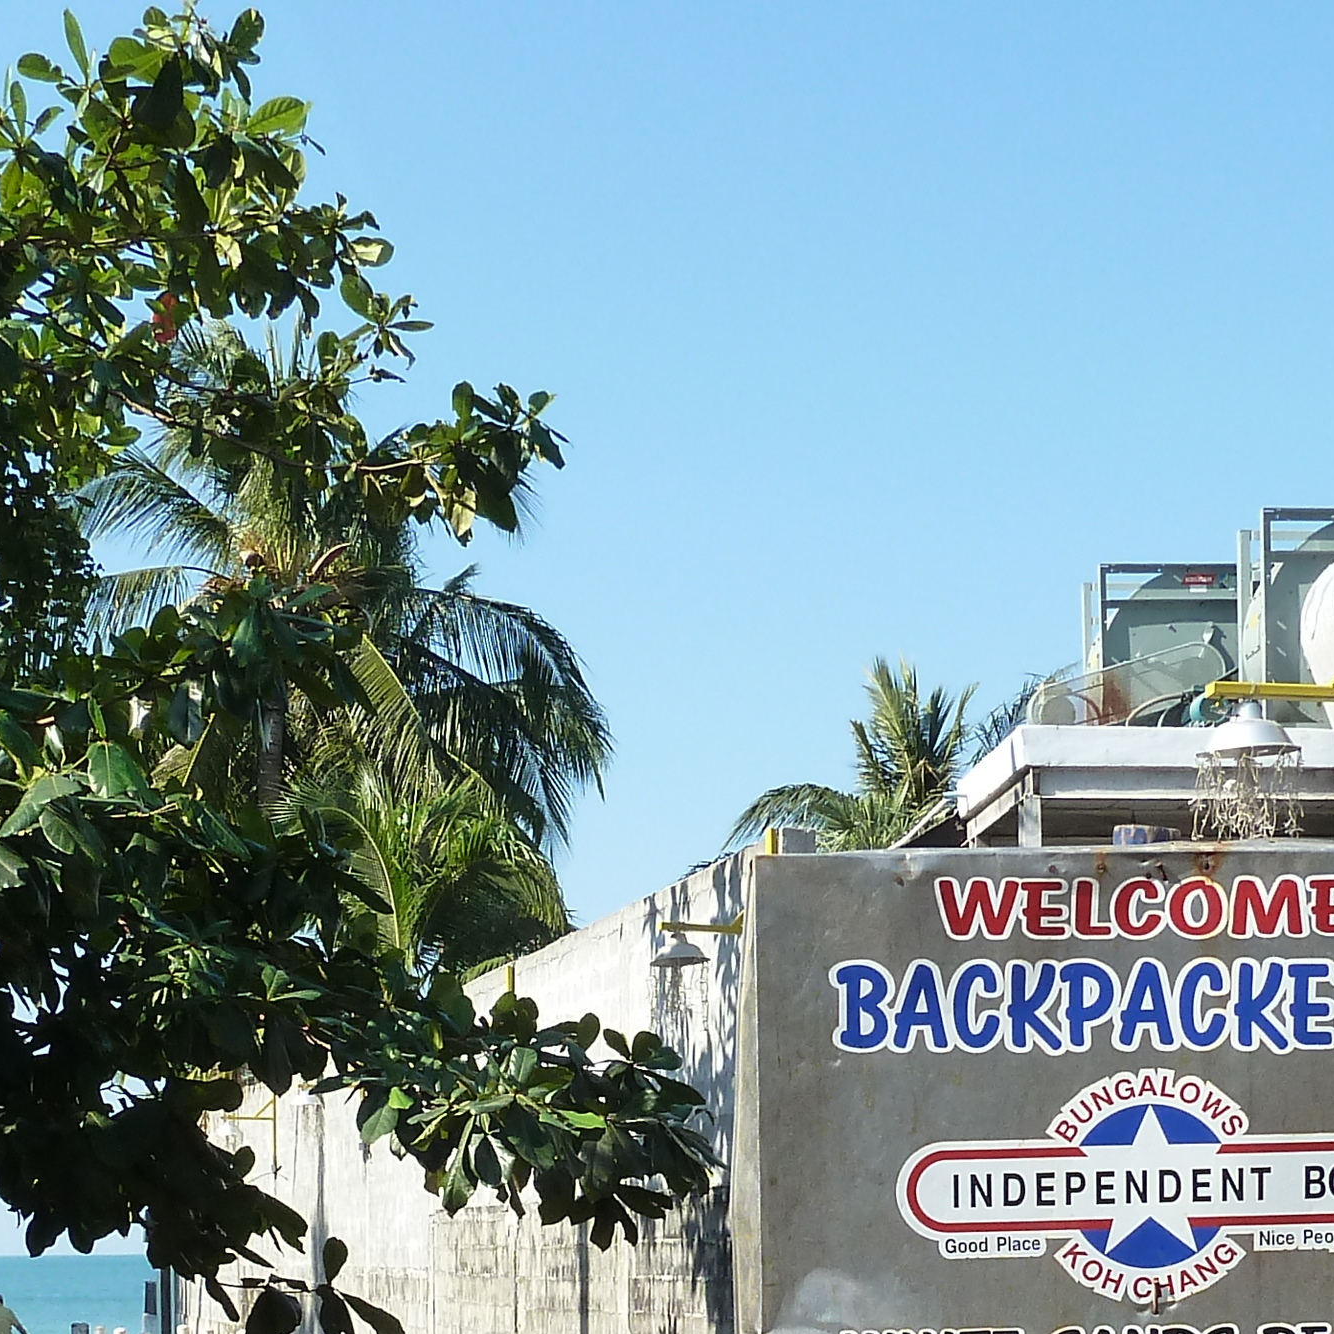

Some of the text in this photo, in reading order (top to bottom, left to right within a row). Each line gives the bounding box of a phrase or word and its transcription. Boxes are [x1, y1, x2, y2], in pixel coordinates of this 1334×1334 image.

[1054, 1075, 1244, 1143] BUNGALOWS
[951, 1166, 1273, 1209] INDEPENDENT
[944, 1235, 1042, 1254] Good Place
[1258, 1230, 1296, 1247] Nice
[1062, 1242, 1239, 1299] KOH CHANG
